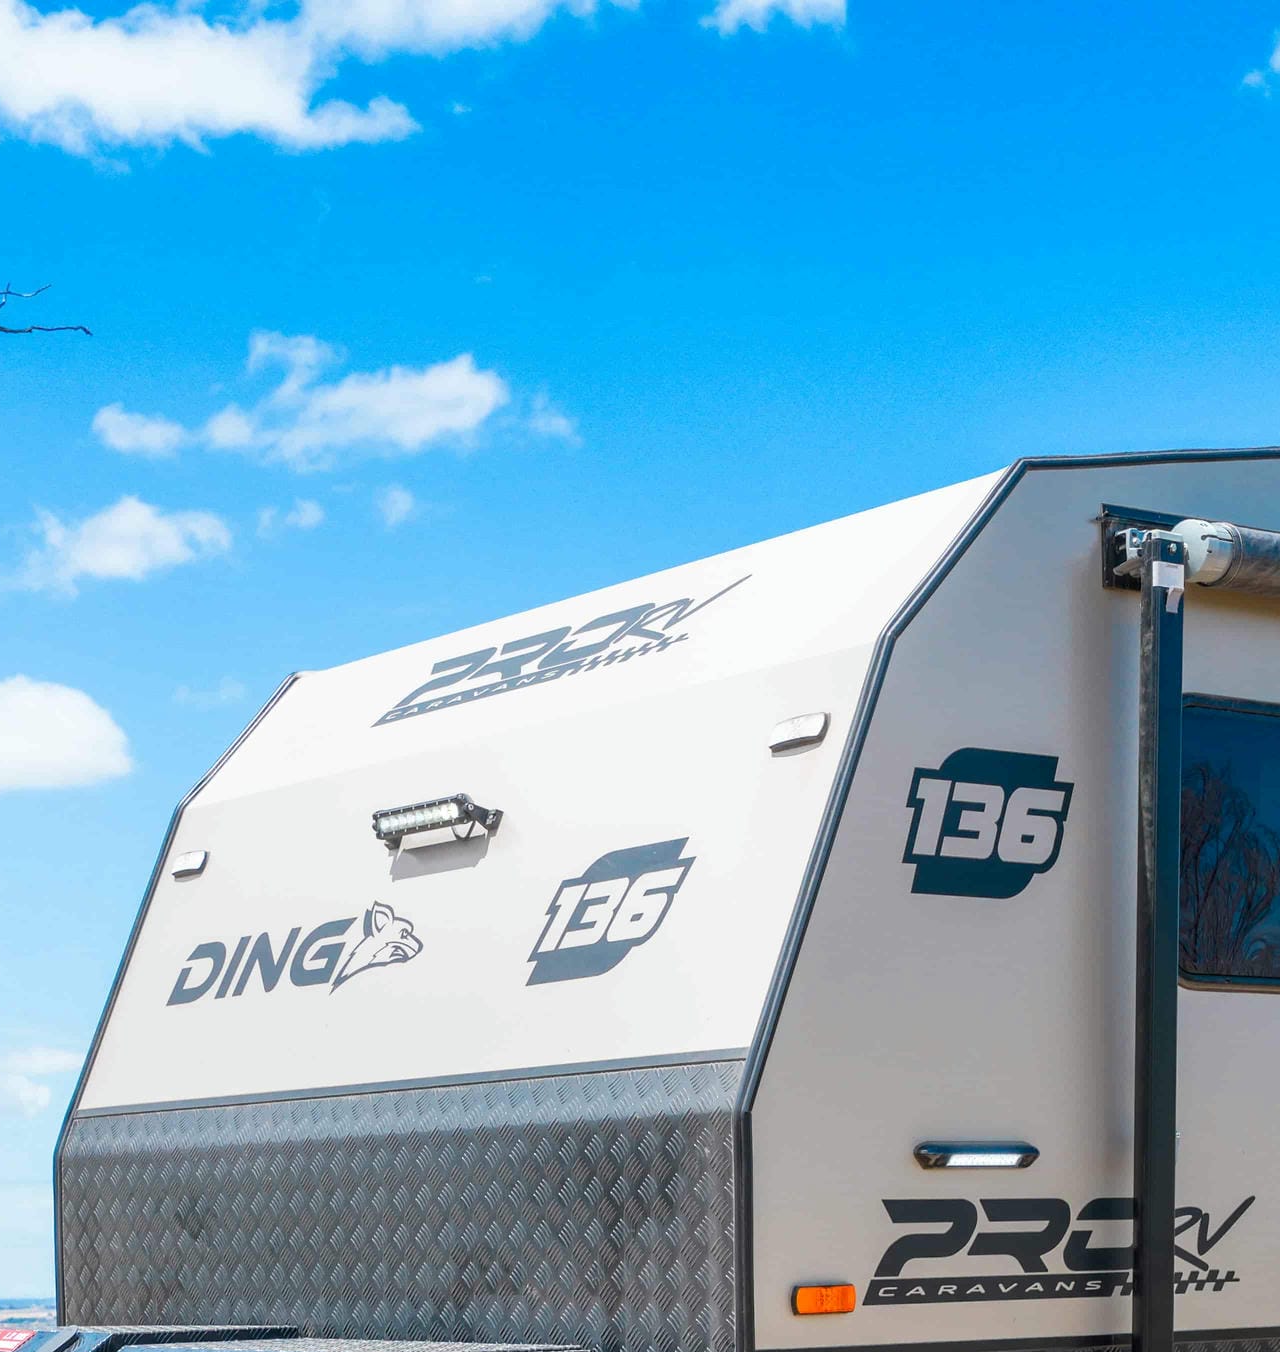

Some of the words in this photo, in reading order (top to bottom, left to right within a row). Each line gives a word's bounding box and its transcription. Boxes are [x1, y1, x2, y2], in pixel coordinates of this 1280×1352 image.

[384, 670, 561, 720] CARAVANS
[912, 777, 1066, 865] 136
[537, 866, 685, 953] 136
[878, 1280, 1102, 1298] CARAVANS
